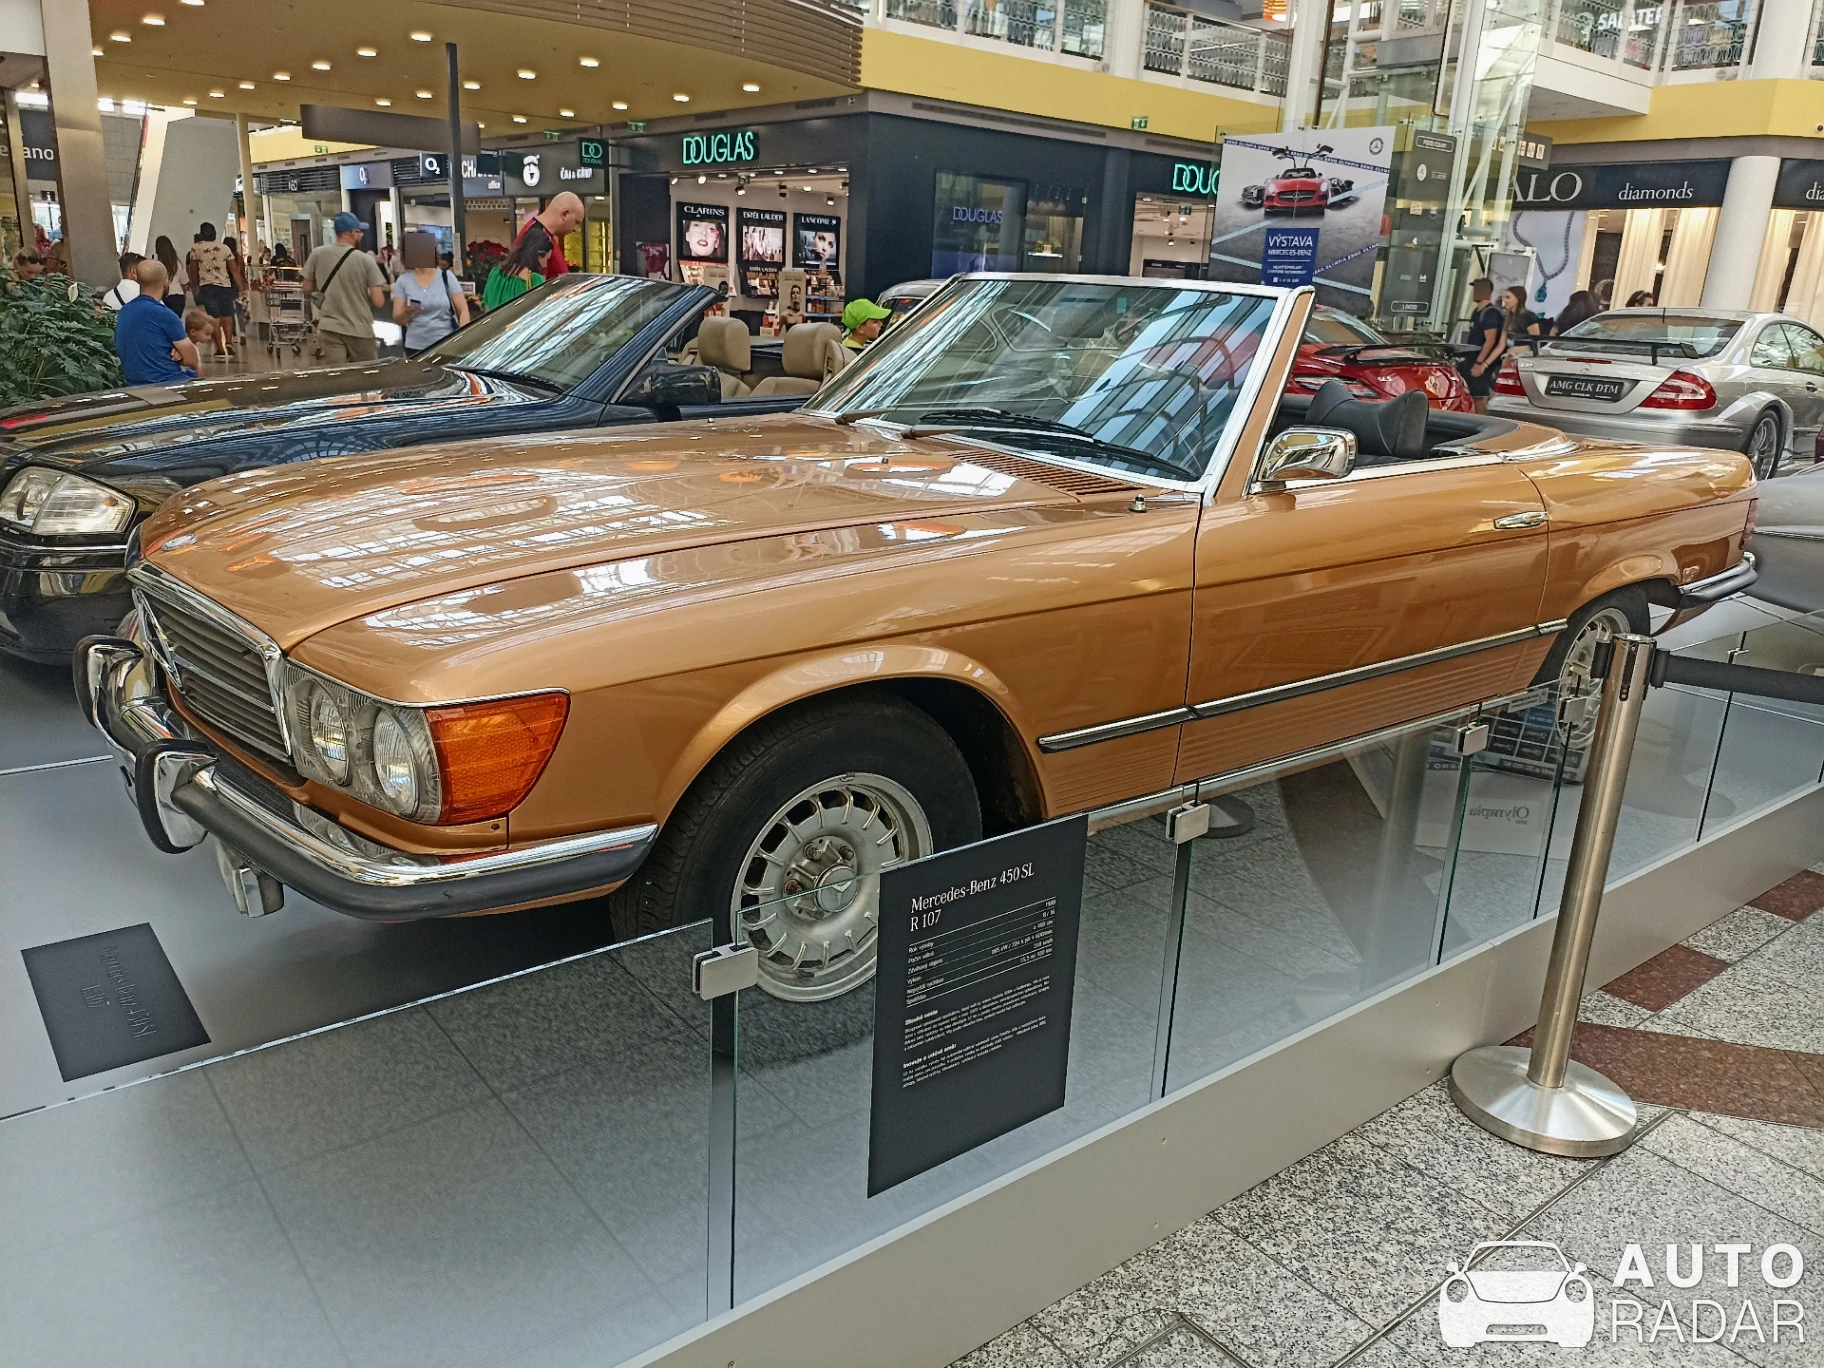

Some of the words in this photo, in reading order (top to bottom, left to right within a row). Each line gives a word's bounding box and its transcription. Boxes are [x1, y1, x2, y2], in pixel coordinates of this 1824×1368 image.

[683, 131, 754, 164] DOUGLAS
[1618, 181, 1694, 201] diamonds
[683, 205, 725, 217] CLARINS
[760, 212, 784, 222] LAUDER
[953, 206, 1003, 224] DOUGLAS
[1268, 234, 1313, 247] VÝSTAVA
[1268, 249, 1312, 257] MERCEDES-BENZ
[1549, 380, 1573, 390] AMG
[1574, 382, 1594, 392] CLK
[1596, 384, 1619, 394] DTM
[910, 877, 997, 914] Mercedes-Benz
[1000, 867, 1020, 885] 450
[1021, 862, 1035, 879] SL
[910, 917, 919, 932] R
[922, 909, 942, 928] 107
